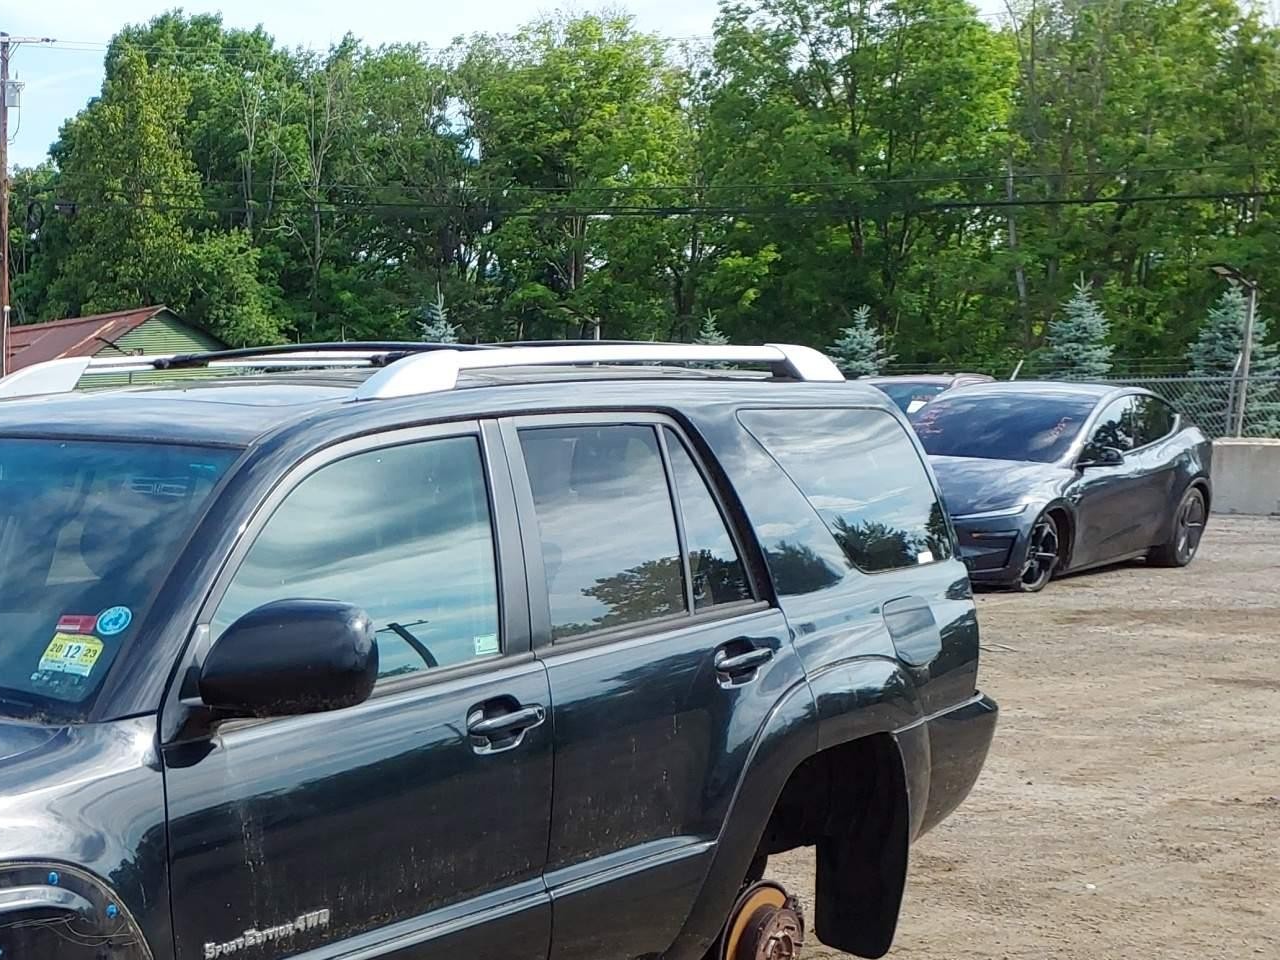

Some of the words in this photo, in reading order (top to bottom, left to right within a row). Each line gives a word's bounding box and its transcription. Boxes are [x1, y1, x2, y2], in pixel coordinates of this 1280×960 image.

[49, 643, 64, 653] 20
[63, 644, 82, 659] 12
[83, 648, 98, 658] 23
